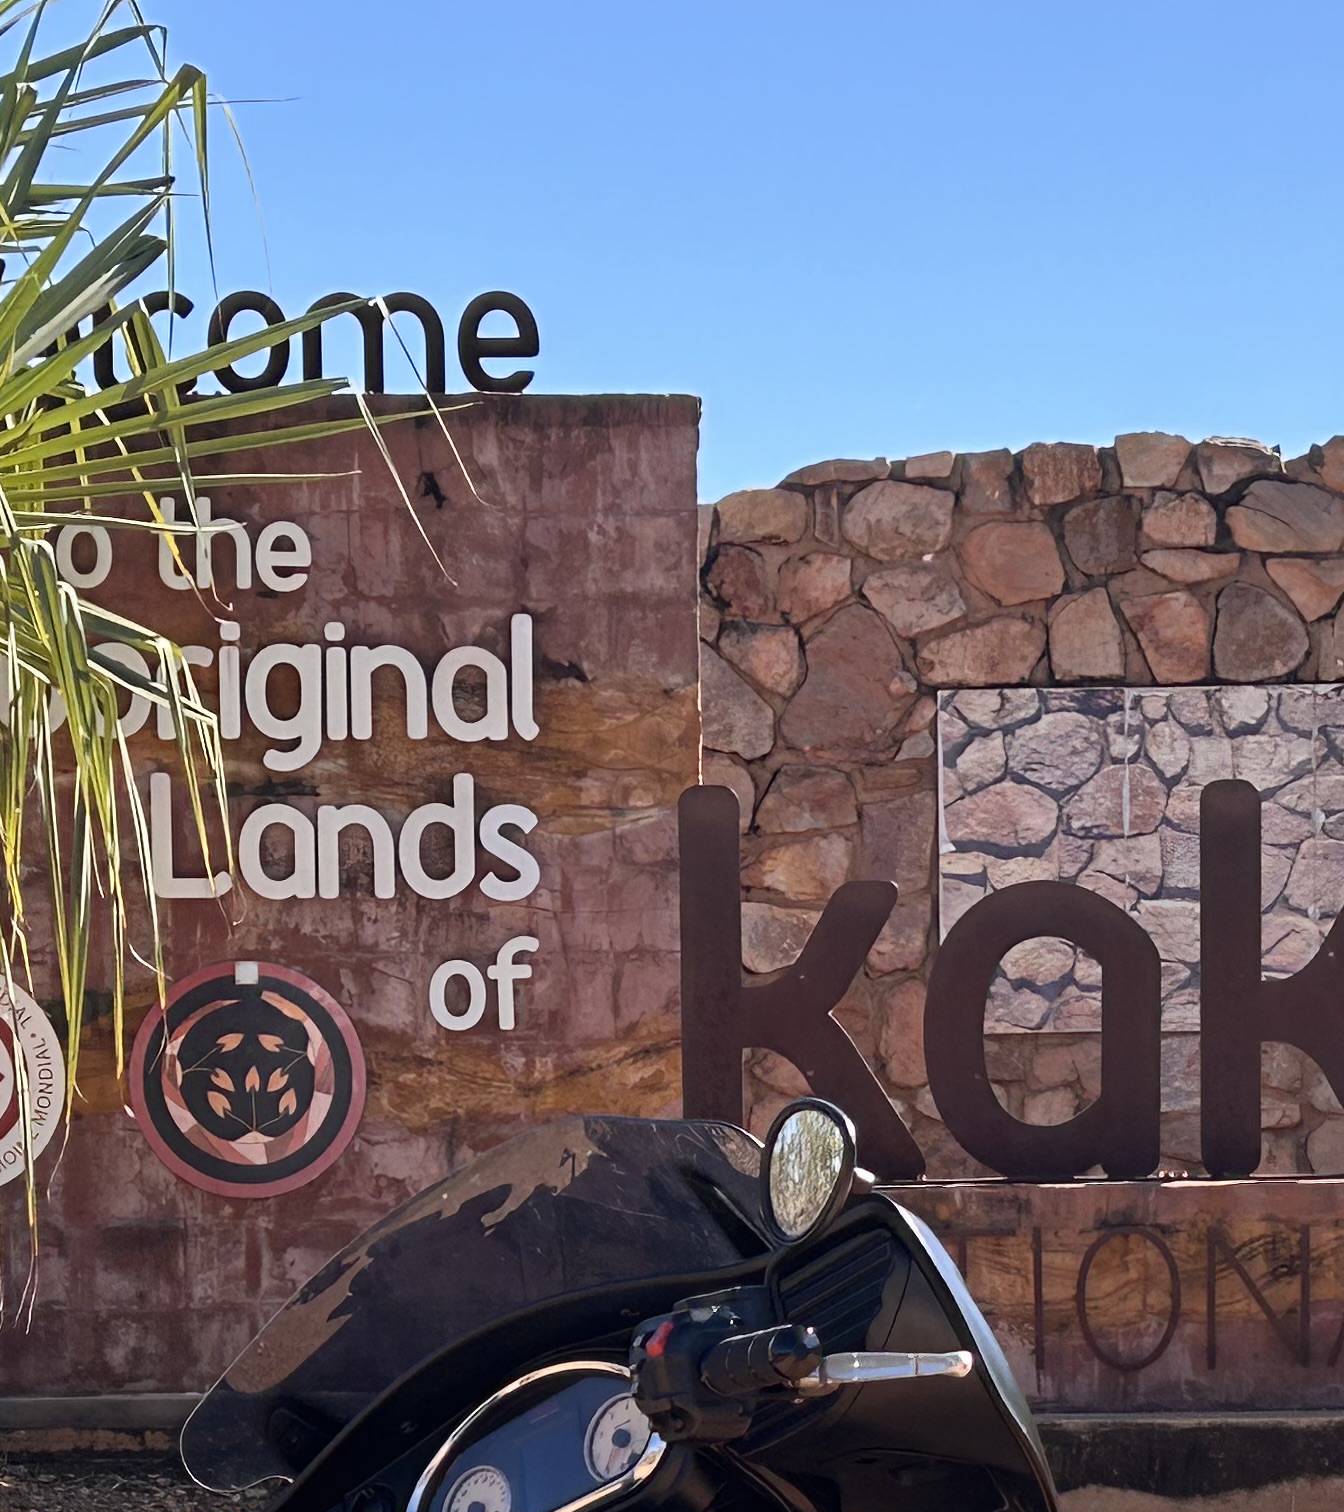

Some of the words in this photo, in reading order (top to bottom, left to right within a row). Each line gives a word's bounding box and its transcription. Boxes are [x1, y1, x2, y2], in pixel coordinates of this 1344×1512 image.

[56, 524, 113, 589] o
[158, 496, 311, 592] the
[150, 772, 541, 901] Lands
[428, 935, 540, 1031] of
[30, 1037, 54, 1127] MONDIAL
